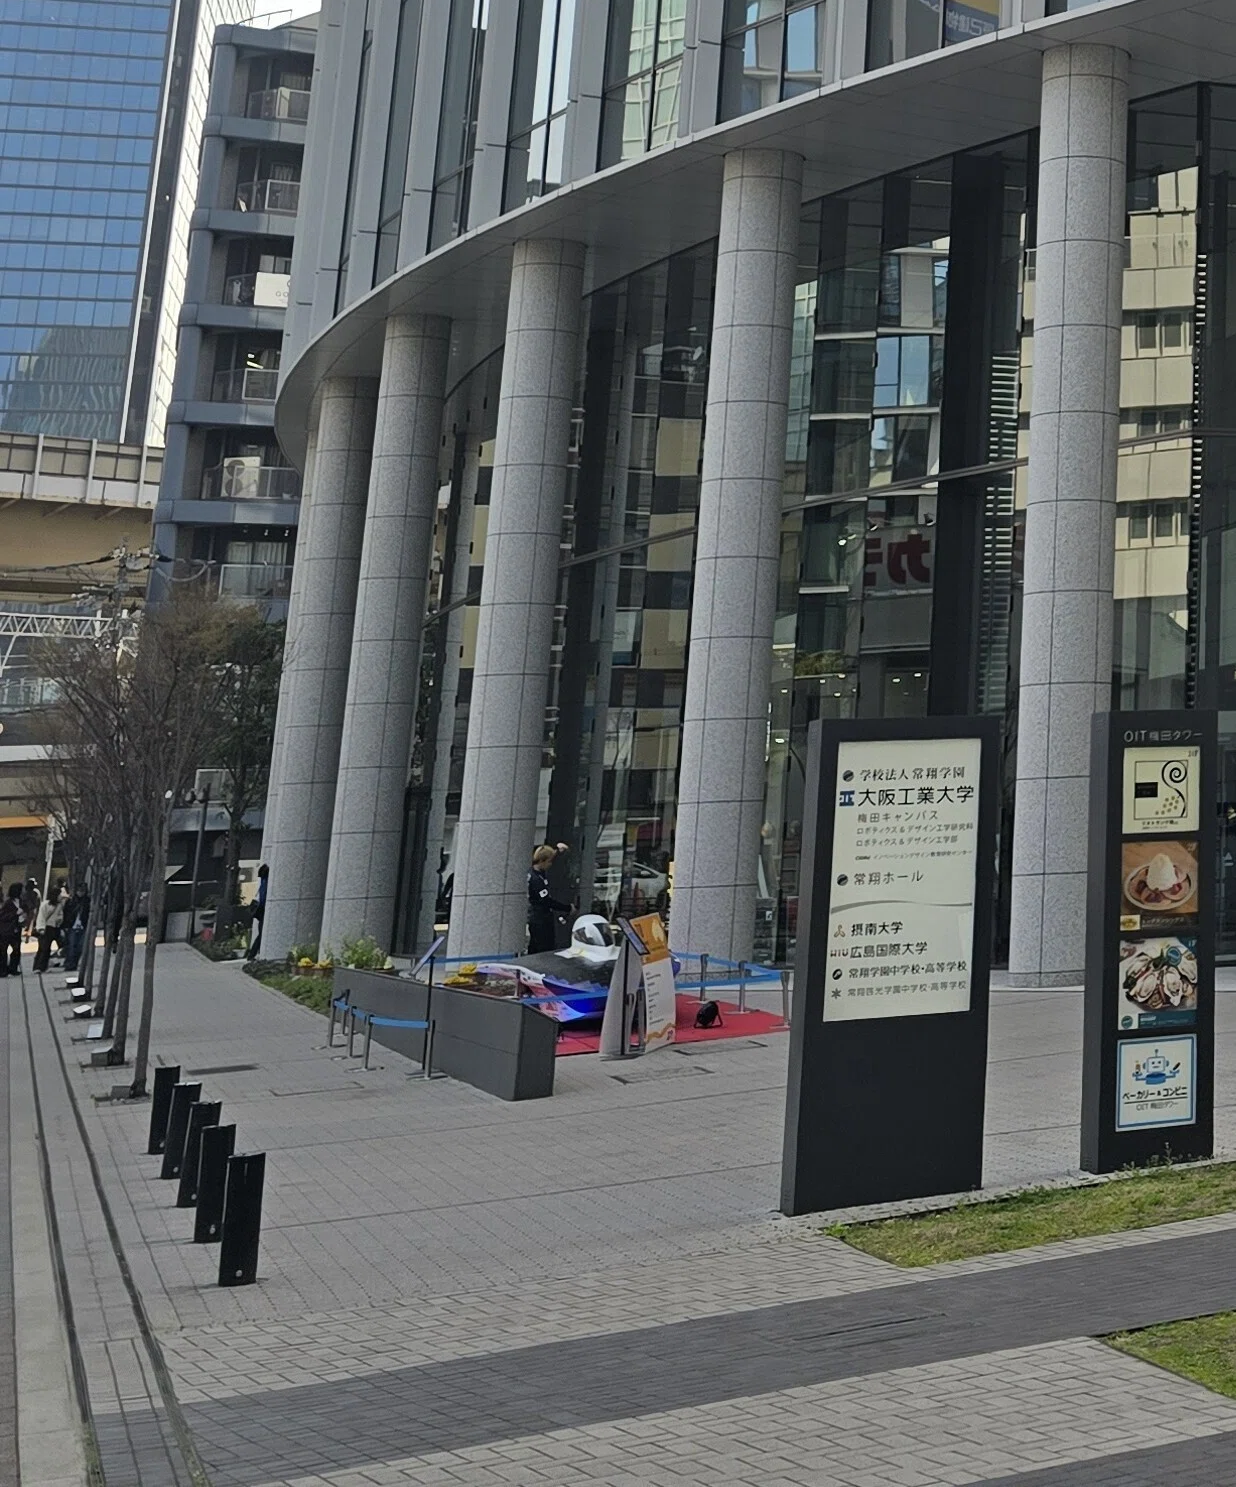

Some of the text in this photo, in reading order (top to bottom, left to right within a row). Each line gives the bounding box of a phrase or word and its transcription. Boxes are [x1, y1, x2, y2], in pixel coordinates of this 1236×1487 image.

[1123, 729, 1147, 743] OIT
[859, 766, 965, 782] 学校法人常翔学園
[857, 785, 974, 807] 大阪工業大学
[857, 810, 938, 823] 梅田キャンパス
[853, 870, 924, 886] 常翔ホール
[850, 921, 904, 937] 摂南大学
[850, 941, 928, 959] 広島国際大学
